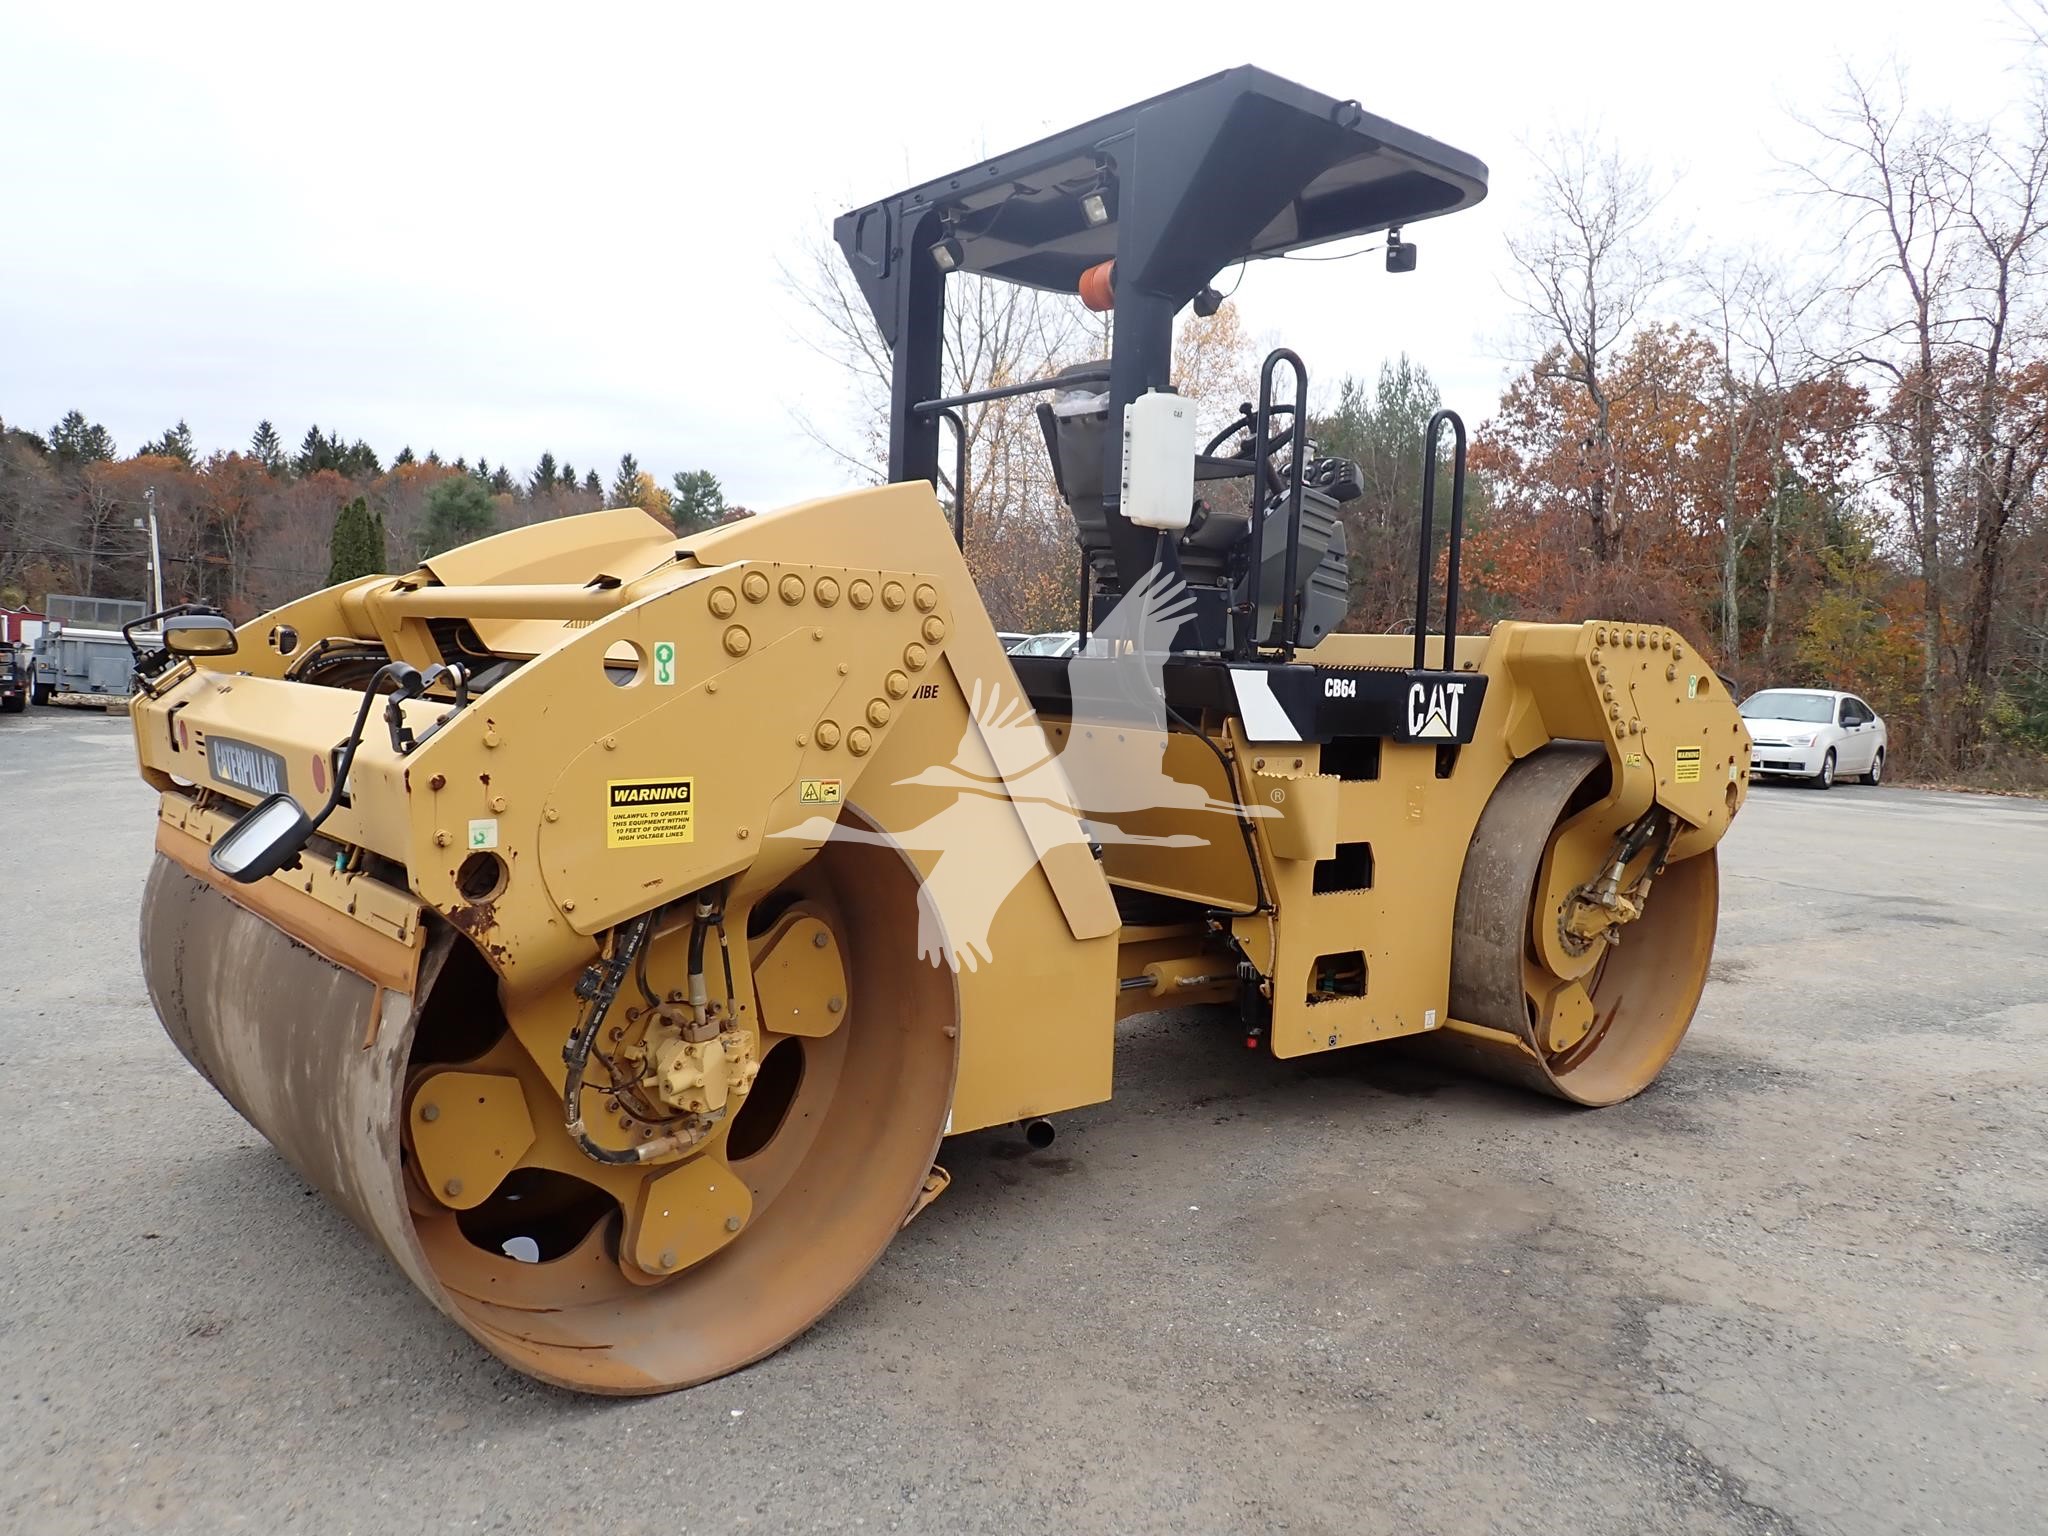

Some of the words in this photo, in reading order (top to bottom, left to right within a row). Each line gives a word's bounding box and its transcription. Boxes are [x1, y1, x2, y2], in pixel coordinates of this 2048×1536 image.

[1324, 678, 1357, 698] CB64
[1408, 683, 1465, 737] CAT
[214, 741, 279, 795] CATERPILLAR
[614, 787, 688, 802] WARNING
[614, 812, 648, 820] UNLAWFUL
[629, 818, 666, 826] EQUIPMENT
[653, 824, 686, 832] OVERHEAD
[636, 832, 664, 840] VOLTAGE
